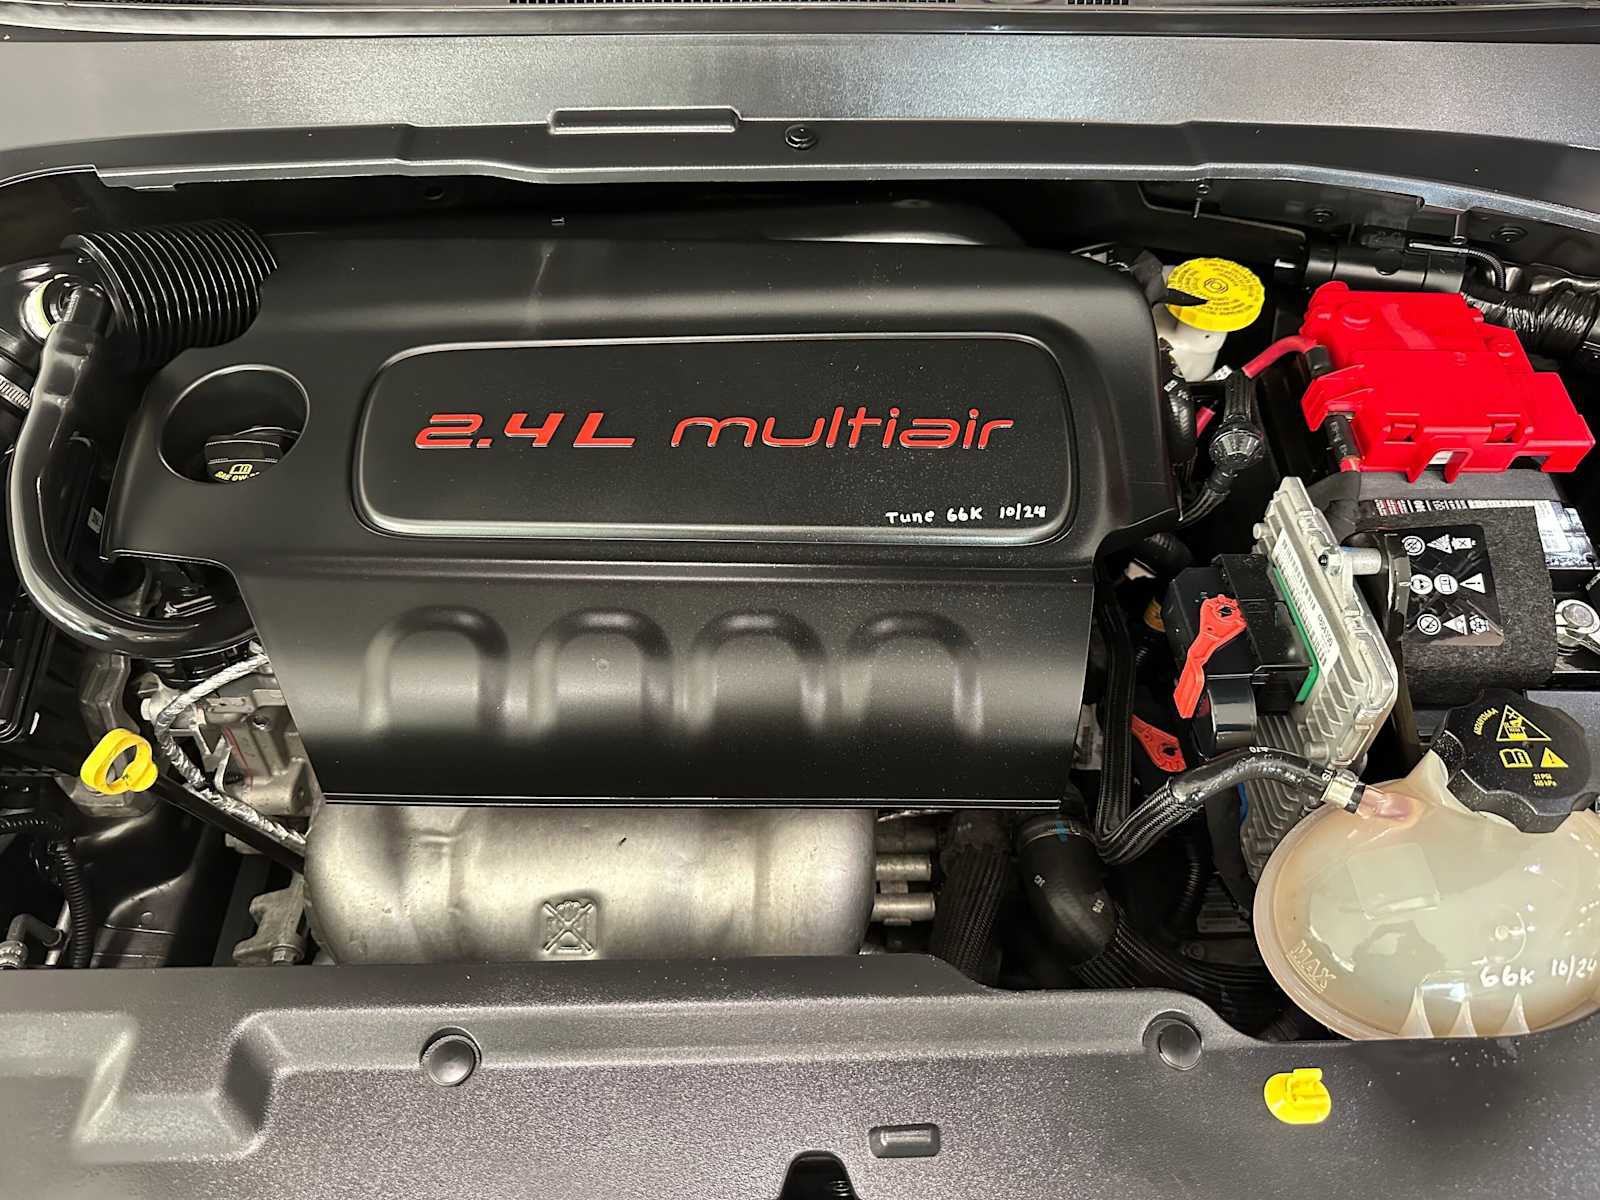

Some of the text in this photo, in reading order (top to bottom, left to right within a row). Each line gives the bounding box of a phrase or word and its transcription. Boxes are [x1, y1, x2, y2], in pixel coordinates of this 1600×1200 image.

[415, 406, 1014, 449] 2.4L multiair
[946, 507, 983, 522] 66K
[999, 502, 1046, 520] 10/24
[1289, 939, 1337, 990] MAX
